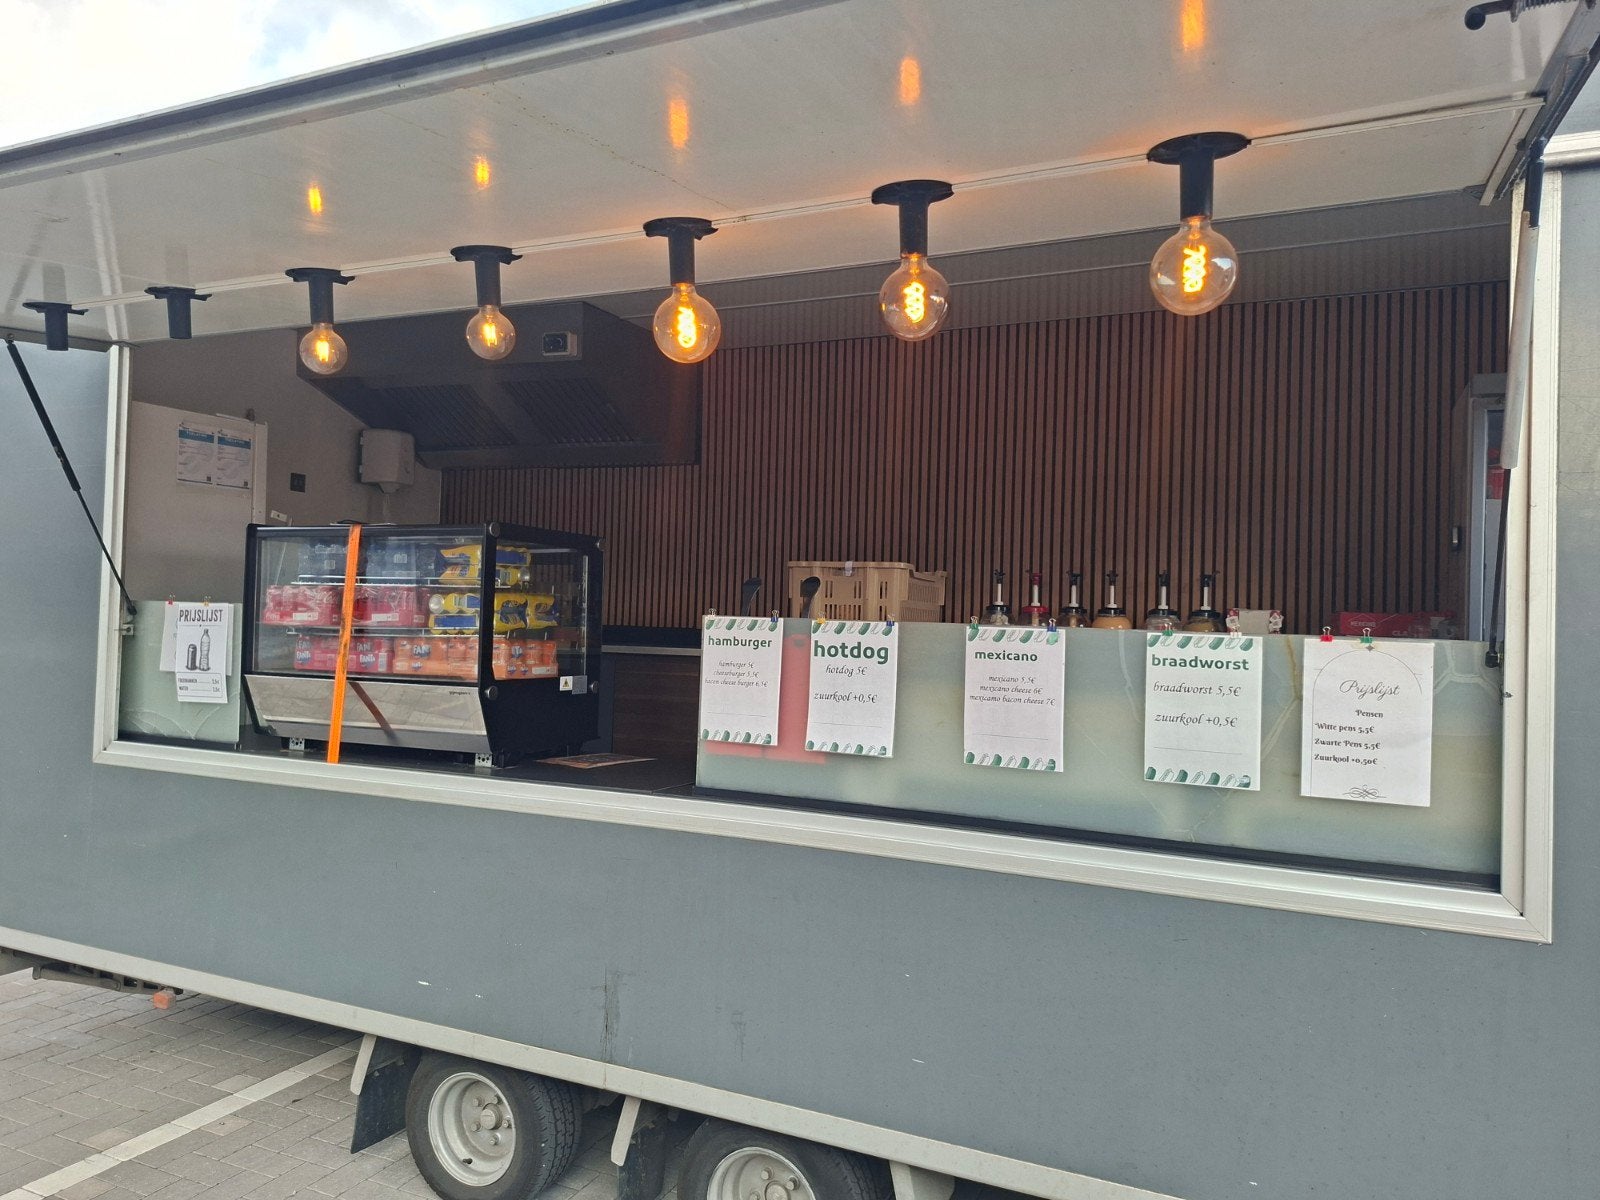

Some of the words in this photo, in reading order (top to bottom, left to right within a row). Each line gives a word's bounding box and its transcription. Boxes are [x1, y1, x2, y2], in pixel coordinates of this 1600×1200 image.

[179, 609, 223, 622] PRIJSLIJST
[708, 635, 772, 650] hamburger
[814, 640, 889, 665] hotdog
[975, 650, 1038, 661] mexicano
[719, 660, 746, 670] hamburger
[1151, 654, 1249, 670] braadworst
[825, 664, 853, 677] hotdog
[857, 666, 867, 675] 5€
[737, 679, 754, 688] burger
[980, 685, 1010, 693] mexicano
[1011, 686, 1031, 694] cheese
[1153, 681, 1213, 695] braadworst
[1216, 685, 1241, 697] 5,5€
[1339, 680, 1400, 701] Prijslijst
[814, 691, 852, 702] zuurkool
[853, 693, 877, 703] +0,5€
[1002, 694, 1022, 703] bacon
[1023, 696, 1044, 705] cheese
[1046, 698, 1056, 706] 7€
[1355, 709, 1384, 718] Pensen
[1155, 713, 1205, 726] zuurkool
[1206, 716, 1238, 728] +0,5€
[1315, 722, 1337, 731] Witte
[1338, 724, 1356, 733] pens
[1314, 738, 1341, 747] Zwarte
[1343, 739, 1362, 748] Pens
[1314, 753, 1349, 763] Zuurkool
